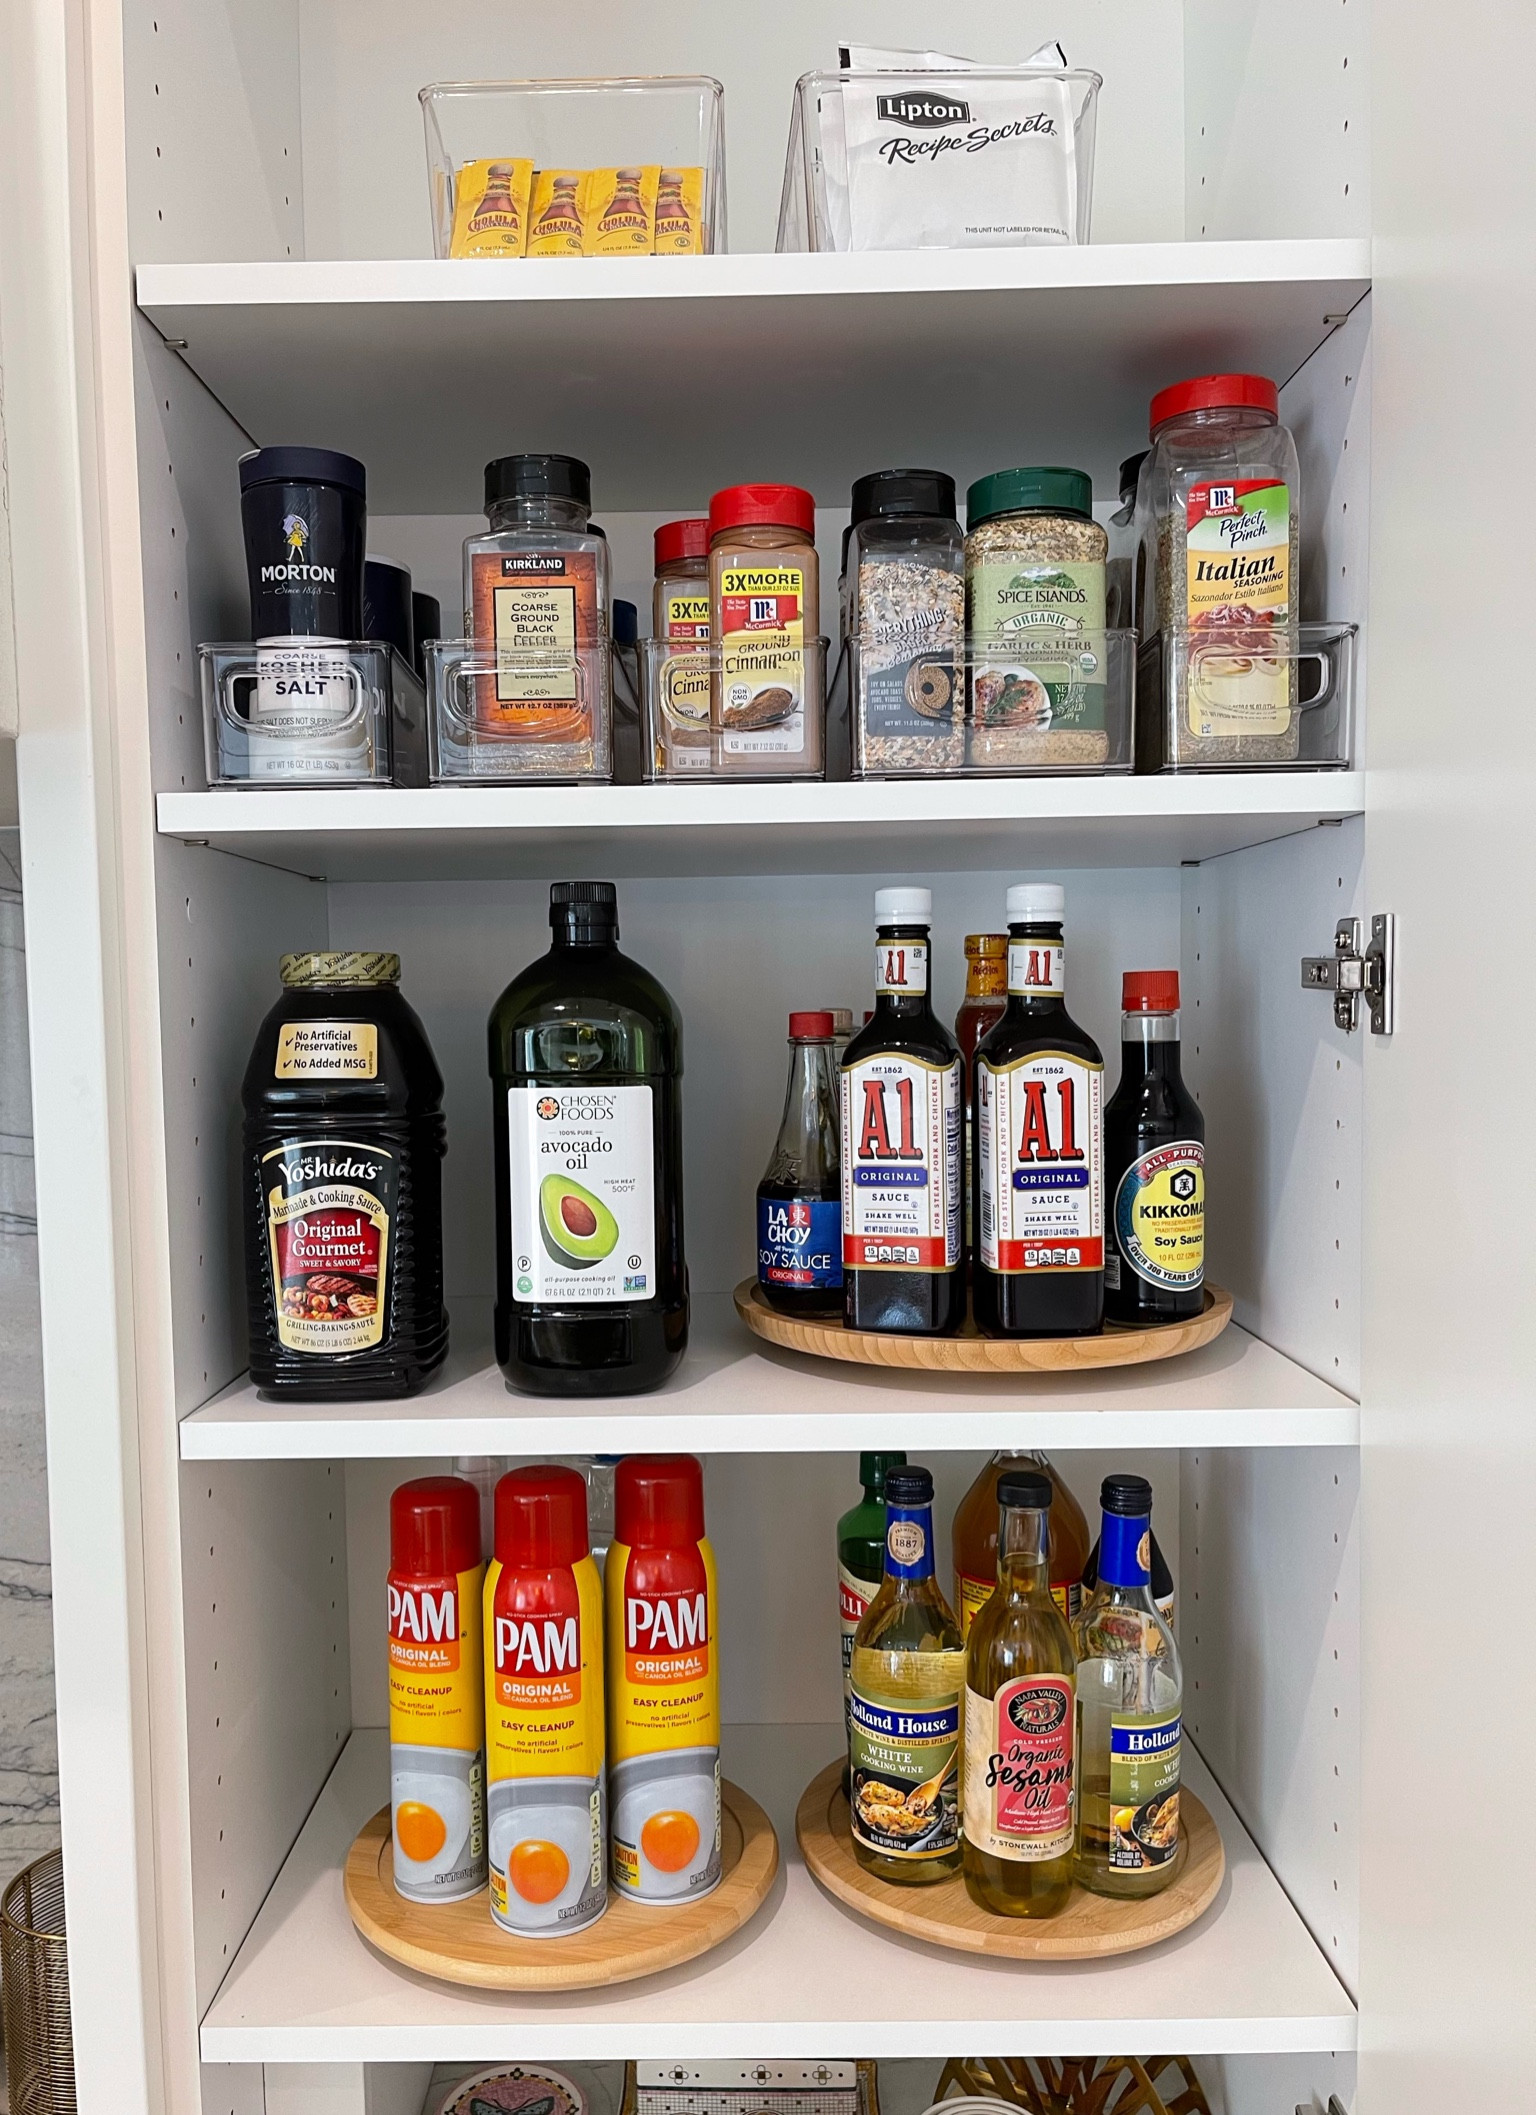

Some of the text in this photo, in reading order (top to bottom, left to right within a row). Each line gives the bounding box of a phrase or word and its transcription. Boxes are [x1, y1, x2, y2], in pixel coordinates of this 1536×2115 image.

[886, 99, 963, 121] Lipton
[878, 112, 1055, 164] Recipe Secrets
[467, 214, 519, 232] CHOLULA
[532, 220, 582, 237] CHOLULA
[597, 216, 648, 232] CHOLULA
[1205, 507, 1238, 516] McCormick
[1220, 511, 1263, 537] Perfect
[1230, 524, 1266, 548] Pinch
[506, 559, 562, 569] KIRKLAND
[1195, 556, 1276, 582] Italian
[262, 565, 335, 582] MORTON
[1233, 570, 1283, 589] SEASONING
[275, 582, 322, 595] Since 1848
[725, 574, 800, 591] 3X MORE
[998, 589, 1086, 604] SPICE ISLANDS
[1191, 584, 1283, 603] Sazonador Estilo Italiano
[512, 603, 558, 612] COARSE
[672, 604, 692, 619] 3X
[511, 614, 559, 622] GROUND
[745, 620, 781, 629] McCormick
[1013, 614, 1068, 628] ORGANIC
[517, 625, 554, 633] BLACK
[873, 608, 944, 645] EVERYTHING
[1055, 641, 1092, 650] HERB
[276, 681, 327, 695] SALT
[296, 1030, 351, 1041] No Artificial
[294, 1041, 357, 1052] Preservatives
[294, 1058, 366, 1069] No Added MSG
[560, 1096, 614, 1107] CHOSEN
[560, 1108, 614, 1120] FOODS
[541, 1137, 613, 1154] avocado
[565, 1154, 588, 1170] oil
[1146, 1155, 1166, 1171] ALL
[278, 1157, 377, 1185] Yoshida's
[861, 1173, 920, 1181] ORIGINAL
[1021, 1174, 1080, 1183] ORIGINAL
[612, 1184, 636, 1194] 500°F
[273, 1190, 381, 1219] Marinade & Cooking Sauce
[1032, 1196, 1070, 1204] SAUCE
[768, 1205, 788, 1226] LA
[790, 1205, 809, 1226] 東
[294, 1218, 362, 1241] Original
[768, 1225, 811, 1245] CHOY
[292, 1239, 366, 1257] Gourmet
[1155, 1237, 1177, 1247] Soy
[299, 1257, 361, 1268] SWEET & SAVORY
[781, 1252, 831, 1270] SAUCE
[1131, 1246, 1148, 1265] OVER
[1148, 1263, 1161, 1275] 300
[1163, 1272, 1186, 1281] YEARS
[1188, 1272, 1195, 1281] OF
[772, 1270, 805, 1281] ORIGINAL
[894, 1538, 917, 1549] 1887
[627, 1592, 706, 1649] PAM
[390, 1645, 448, 1661] ORIGINAL
[495, 1617, 577, 1673] PAM
[635, 1656, 701, 1672] ORIGINAL
[644, 1671, 672, 1680] CANOLA
[685, 1666, 703, 1676] BLEND
[503, 1681, 571, 1696] ORIGINAL
[511, 1696, 537, 1704] CANOLA
[552, 1693, 573, 1702] BLEND
[634, 1692, 704, 1708] EASY CLEANUP
[1016, 1690, 1063, 1705] NAPA VALLEY
[502, 1720, 575, 1732] EASY CLEANUP
[898, 1717, 947, 1734] House
[1020, 1719, 1060, 1734] NATURALS
[876, 1734, 890, 1743] WINE
[898, 1738, 930, 1746] DISTILLED
[931, 1736, 951, 1745] SPIRITS
[1128, 1724, 1180, 1751] Holland
[867, 1744, 912, 1763] WHITE
[1008, 1745, 1065, 1769] Organic
[861, 1754, 924, 1774] COOKING WINE
[1024, 1786, 1051, 1809] Oil
[990, 1837, 996, 1846] by
[999, 1840, 1048, 1850] STONEWALL
